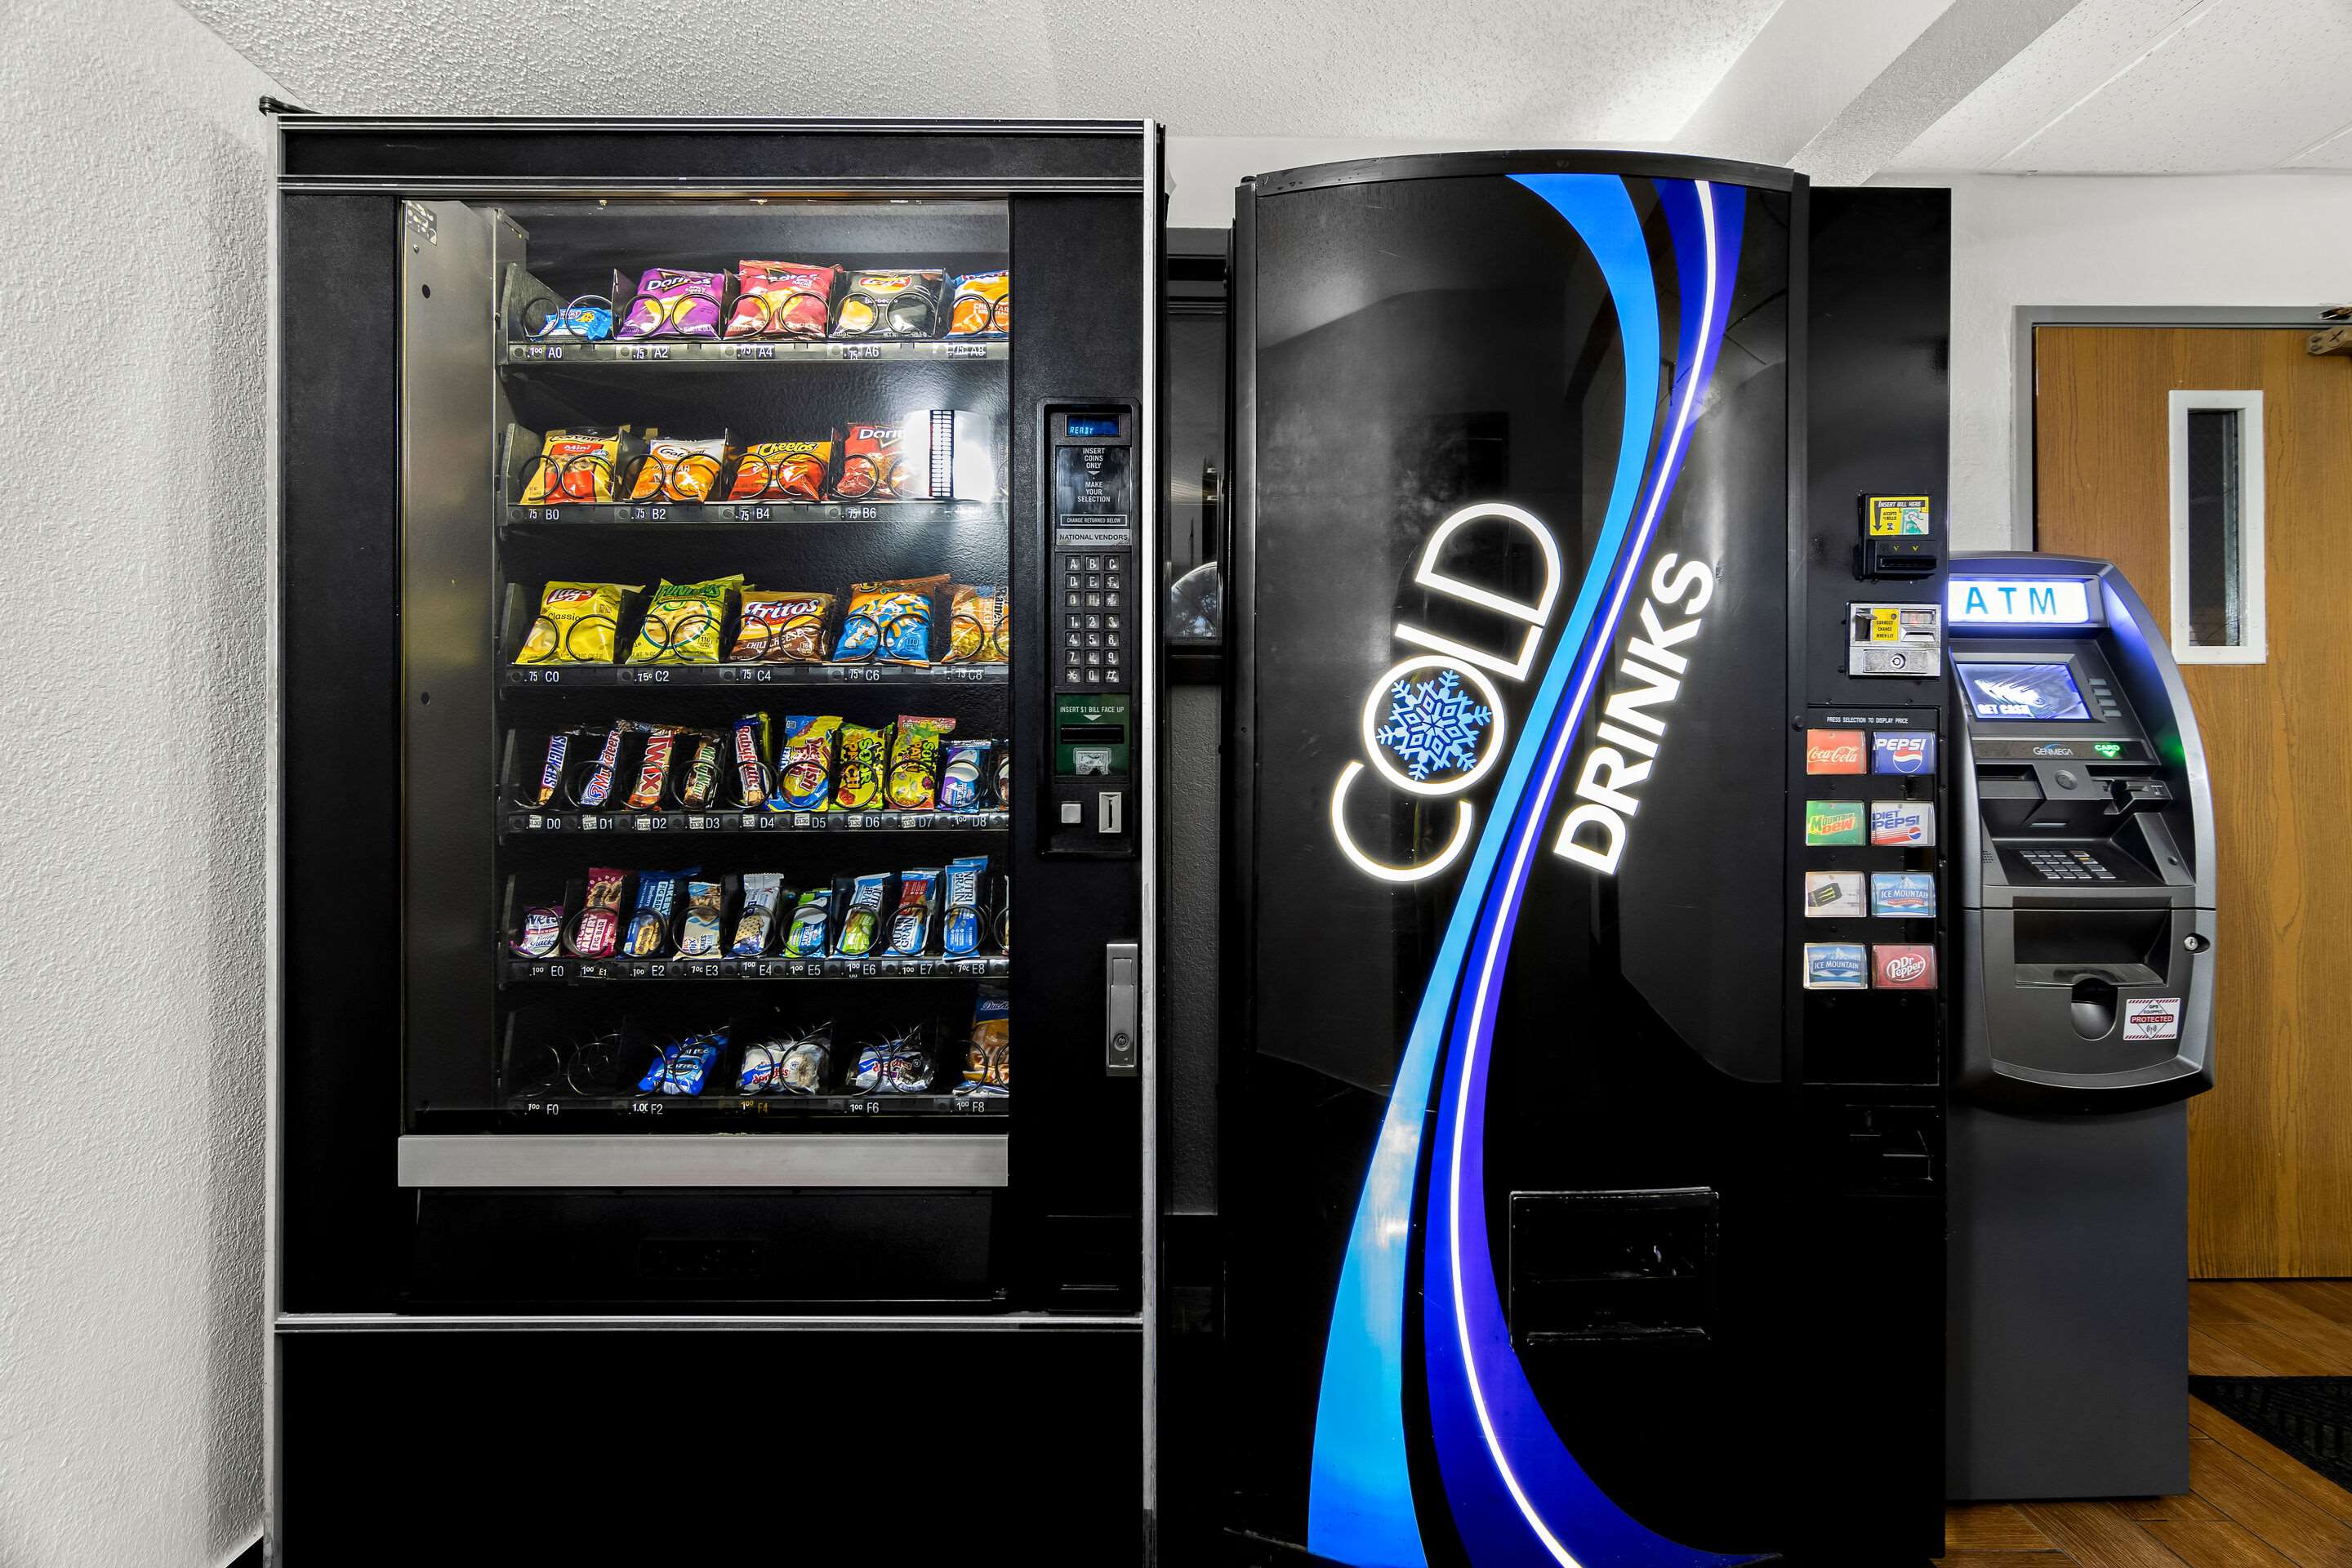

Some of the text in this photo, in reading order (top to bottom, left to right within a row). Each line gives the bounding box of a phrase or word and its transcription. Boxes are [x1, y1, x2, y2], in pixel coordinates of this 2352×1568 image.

[548, 349, 562, 359] A0
[654, 348, 668, 359] A2
[759, 349, 773, 358] A4
[865, 349, 880, 358] A6
[1070, 426, 1094, 434] READY
[759, 442, 818, 456] Cheetos
[546, 509, 559, 520] B0
[653, 509, 666, 520] B2
[756, 507, 770, 519] B4
[863, 508, 876, 519] B6
[1070, 559, 1116, 569] A B C
[1070, 577, 1077, 586] D
[1089, 577, 1096, 587] E
[1089, 595, 1096, 605] H
[1965, 586, 2057, 615] ATM
[744, 600, 819, 620] Fritos
[548, 612, 581, 621] Classic
[1089, 617, 1096, 626] 2
[1069, 635, 1095, 645] 4 5
[1107, 653, 1114, 662] 9
[546, 671, 559, 682] C0
[655, 670, 669, 682] C2
[757, 670, 771, 681] C4
[866, 670, 880, 681] C6
[968, 670, 982, 680] C8
[1089, 670, 1094, 680] 0
[1332, 503, 1561, 882] COLD
[1554, 553, 1714, 875] DRINKS
[1873, 738, 1927, 751] PEPSI
[1808, 746, 1860, 764] Coca-Cola
[543, 734, 568, 788] SNICKERS
[641, 731, 673, 792] TWIX
[1872, 809, 1901, 820] DIET
[547, 819, 560, 829] D0
[600, 818, 612, 829] D1
[653, 818, 666, 829] D2
[706, 818, 719, 829] D3
[760, 817, 774, 828] D4
[813, 817, 826, 828] D5
[866, 817, 880, 828] D6
[919, 817, 933, 828] D7
[972, 817, 987, 827] D8
[1872, 814, 1921, 831] PEPSI
[955, 872, 964, 902] GRAIN
[963, 871, 974, 902] NUTRI
[653, 882, 667, 909] FIG BAR
[1881, 889, 1929, 898] ICE MOUNTAIN
[591, 920, 606, 949] FIG BAR
[901, 917, 915, 948] GRAIN
[1814, 961, 1860, 969] ICE MOUNTAIN
[1901, 956, 1914, 968] Dr
[550, 966, 564, 977] E0
[599, 968, 607, 976] E1
[652, 965, 665, 976] E2
[706, 965, 719, 976] E3
[760, 964, 772, 976] E4
[808, 964, 821, 975] E5
[863, 964, 876, 975] E6
[920, 964, 933, 975] E7
[972, 964, 985, 974] E8
[1891, 960, 1924, 979] Pepper
[546, 1104, 559, 1116] F0
[651, 1104, 663, 1116] F2
[757, 1102, 769, 1113] F4
[866, 1102, 880, 1113] F6
[972, 1102, 985, 1112] F8
